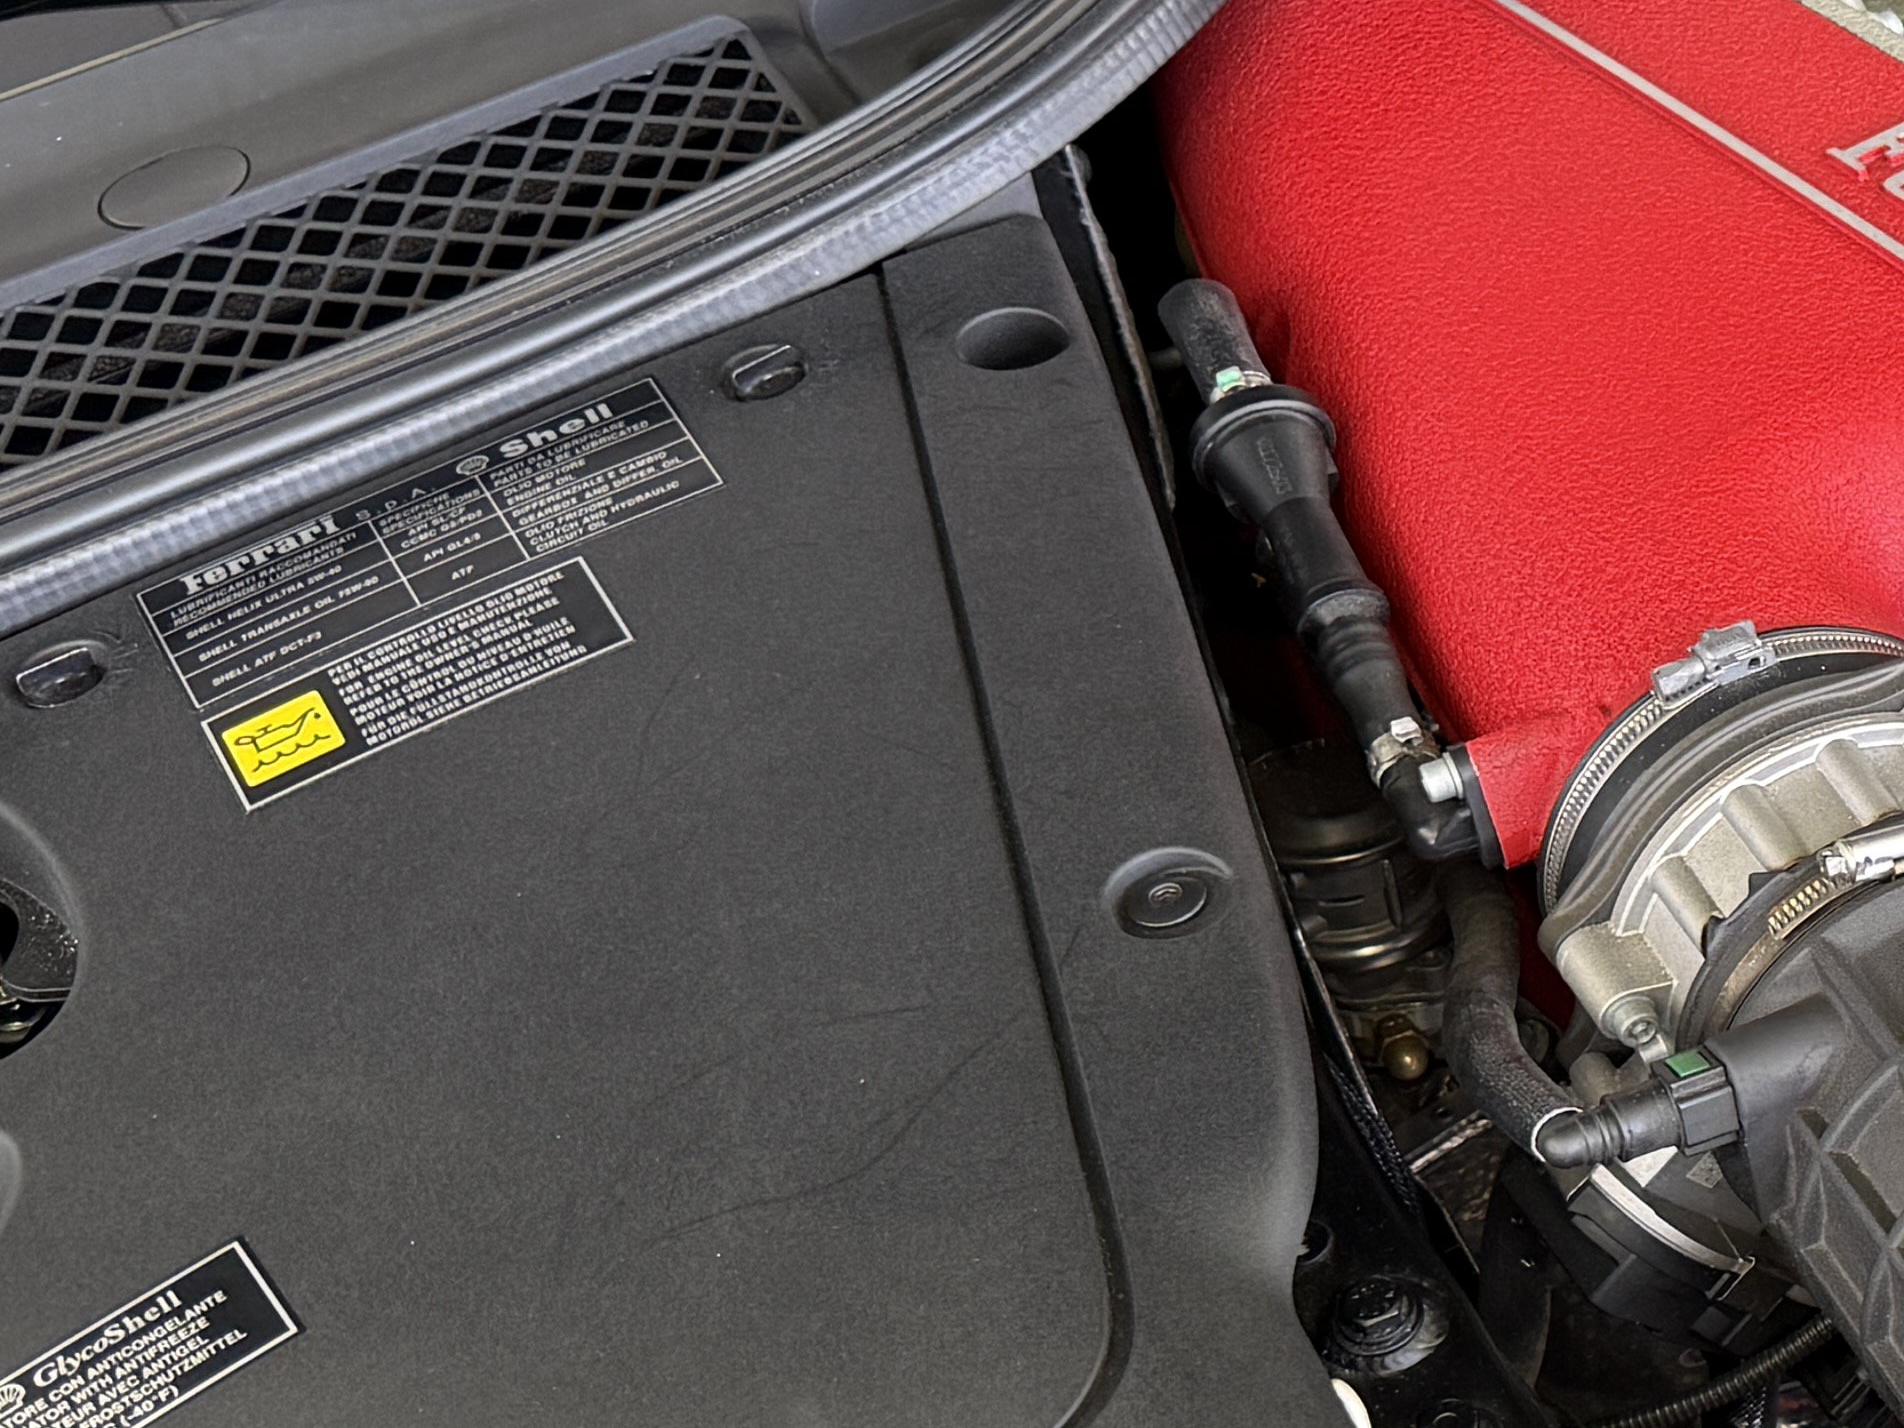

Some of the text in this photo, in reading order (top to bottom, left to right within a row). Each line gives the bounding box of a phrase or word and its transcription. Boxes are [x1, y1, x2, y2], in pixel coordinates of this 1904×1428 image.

[489, 420, 624, 480] PARTI DA LUBRIFICARE
[493, 419, 648, 487] PARTS TO BE LUBRICATED
[499, 403, 612, 457] Shell
[502, 458, 585, 497] OLIO MOTORE
[506, 473, 576, 505] ENGINE OIL
[511, 450, 666, 517] DIFFERENZIALE E CAMBIO
[518, 496, 577, 525] GEARBOX
[584, 483, 609, 499] AND
[660, 455, 683, 468] OIL
[378, 492, 449, 526] SPECIFICHE
[382, 488, 480, 534] SPECIFICATIONS
[407, 522, 428, 536] API
[524, 496, 612, 538] OLIO FRIZIONE
[529, 480, 679, 545] CLUTCH AND HYDRAULIC
[535, 518, 608, 552] CIRCUIT OIL
[170, 531, 356, 618] LUBRIFICANTI RACCOMANDATI
[179, 515, 338, 594] Ferrari
[423, 547, 444, 562] API
[451, 564, 473, 580] ATF
[173, 546, 343, 626] RECOMMENDED LUBRICANTS
[185, 617, 224, 639] SHELL
[226, 599, 262, 620] HELIX
[264, 581, 304, 603] ULTRA
[198, 639, 237, 662] SHELL
[240, 604, 311, 641] TRANSAXLE
[313, 595, 335, 609] OIL
[211, 663, 251, 686] SHELL
[254, 650, 276, 667] ATF
[32, 1290, 181, 1387] GlycoShell
[47, 1374, 85, 1402] CON
[86, 1290, 226, 1380] ANTICONGELANTE
[70, 1373, 113, 1404] WITH
[114, 1316, 209, 1379] ANTIFREEZE
[97, 1374, 140, 1406] AVEC
[141, 1335, 209, 1379] ANTIGEL
